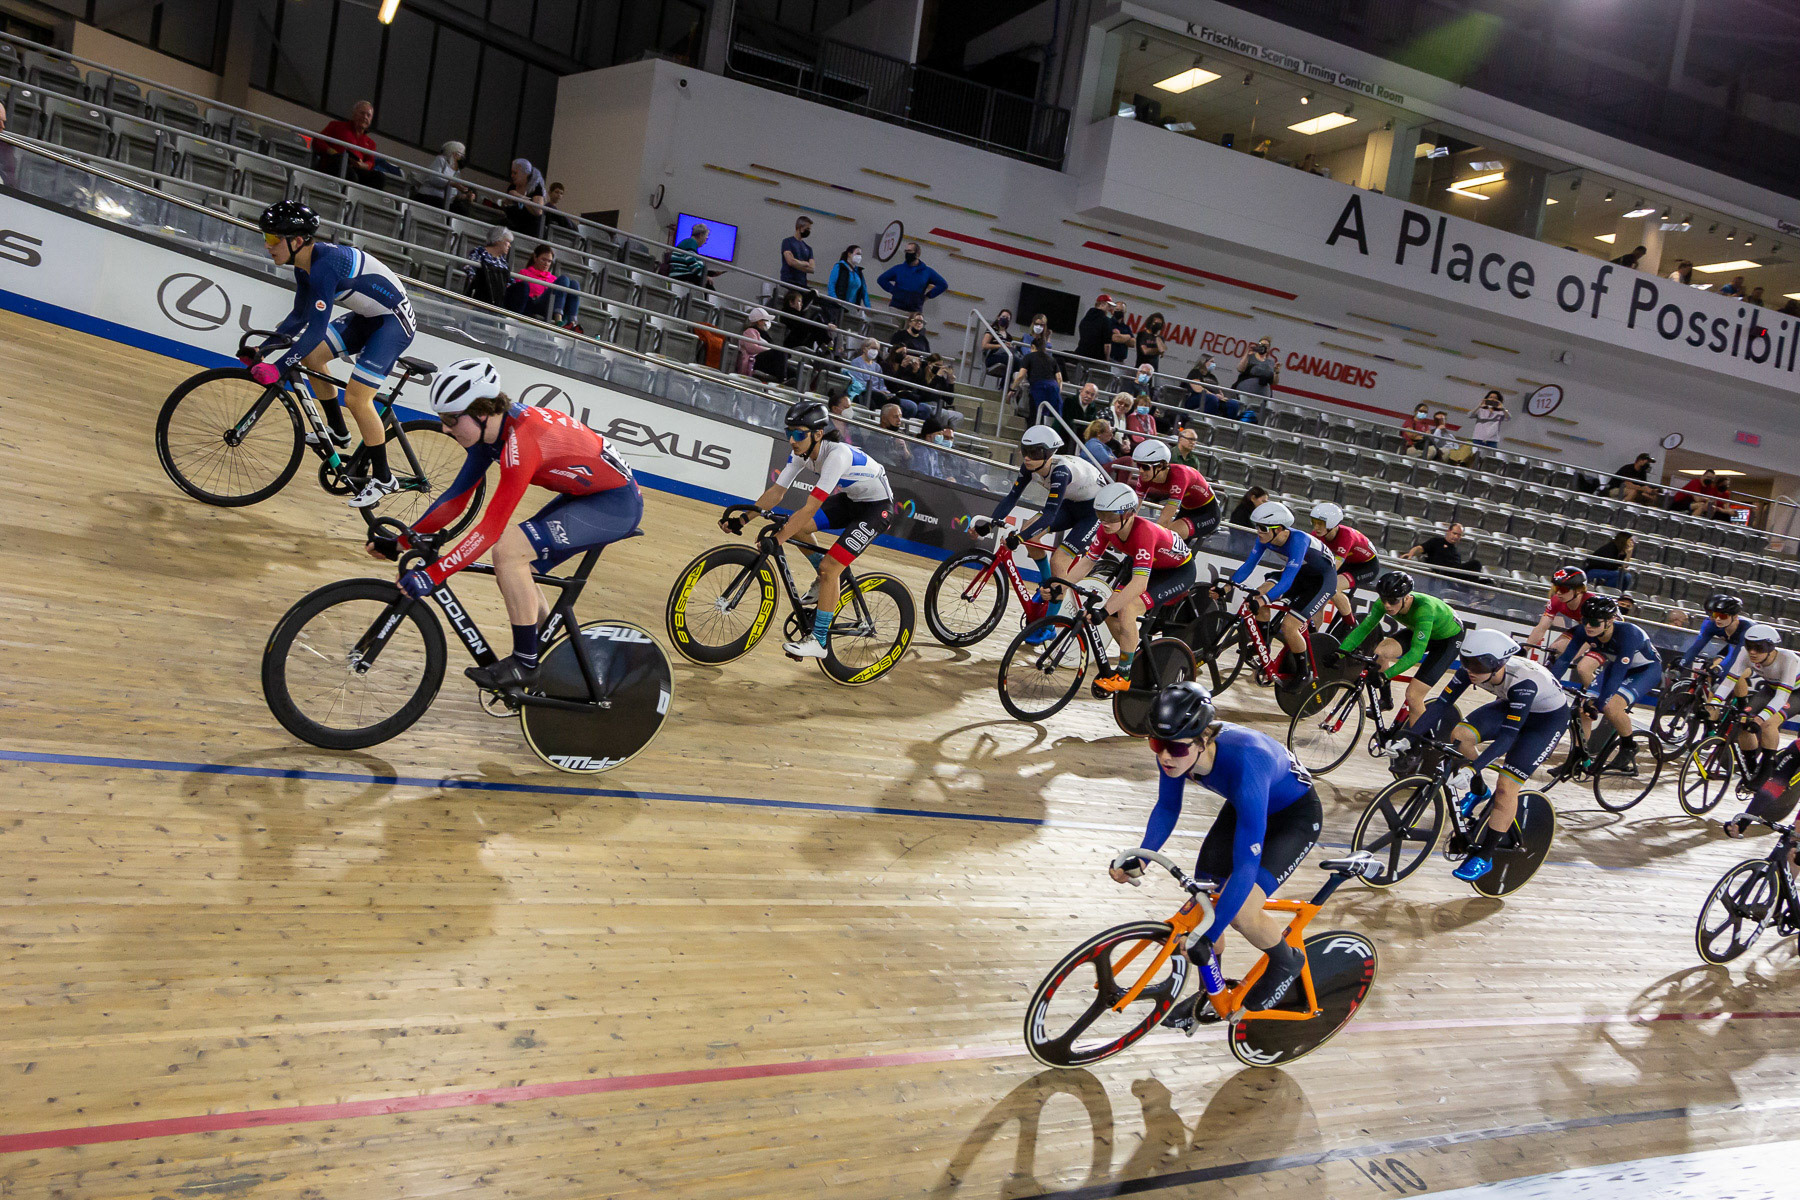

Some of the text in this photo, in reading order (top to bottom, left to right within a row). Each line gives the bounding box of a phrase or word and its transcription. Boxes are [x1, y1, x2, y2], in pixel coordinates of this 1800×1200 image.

[1186, 21, 1404, 104] K. Frischkorn Scoring Timing Control Room
[1325, 193, 1369, 256] A
[1395, 208, 1536, 300] Place
[1556, 264, 1614, 320] of
[1285, 351, 1378, 389] CANADIENS
[1535, 398, 1552, 410] 112
[580, 407, 732, 471] LEXUS
[792, 480, 814, 493] MILTO
[844, 521, 875, 552] OBC
[913, 512, 939, 525] MILTON
[1081, 518, 1102, 543] TORONT
[460, 531, 481, 552] CYCLING
[463, 534, 486, 559] ACADEMY
[438, 549, 462, 573] KW
[1006, 558, 1031, 602] cervélo
[435, 587, 488, 656] DOLAN
[1309, 591, 1331, 617] ALBERTA
[1247, 617, 1269, 664] cervélo
[1532, 729, 1562, 768] TORONTO
[1277, 841, 1315, 885] MARIPOSA
[1368, 1158, 1428, 1194] 10
